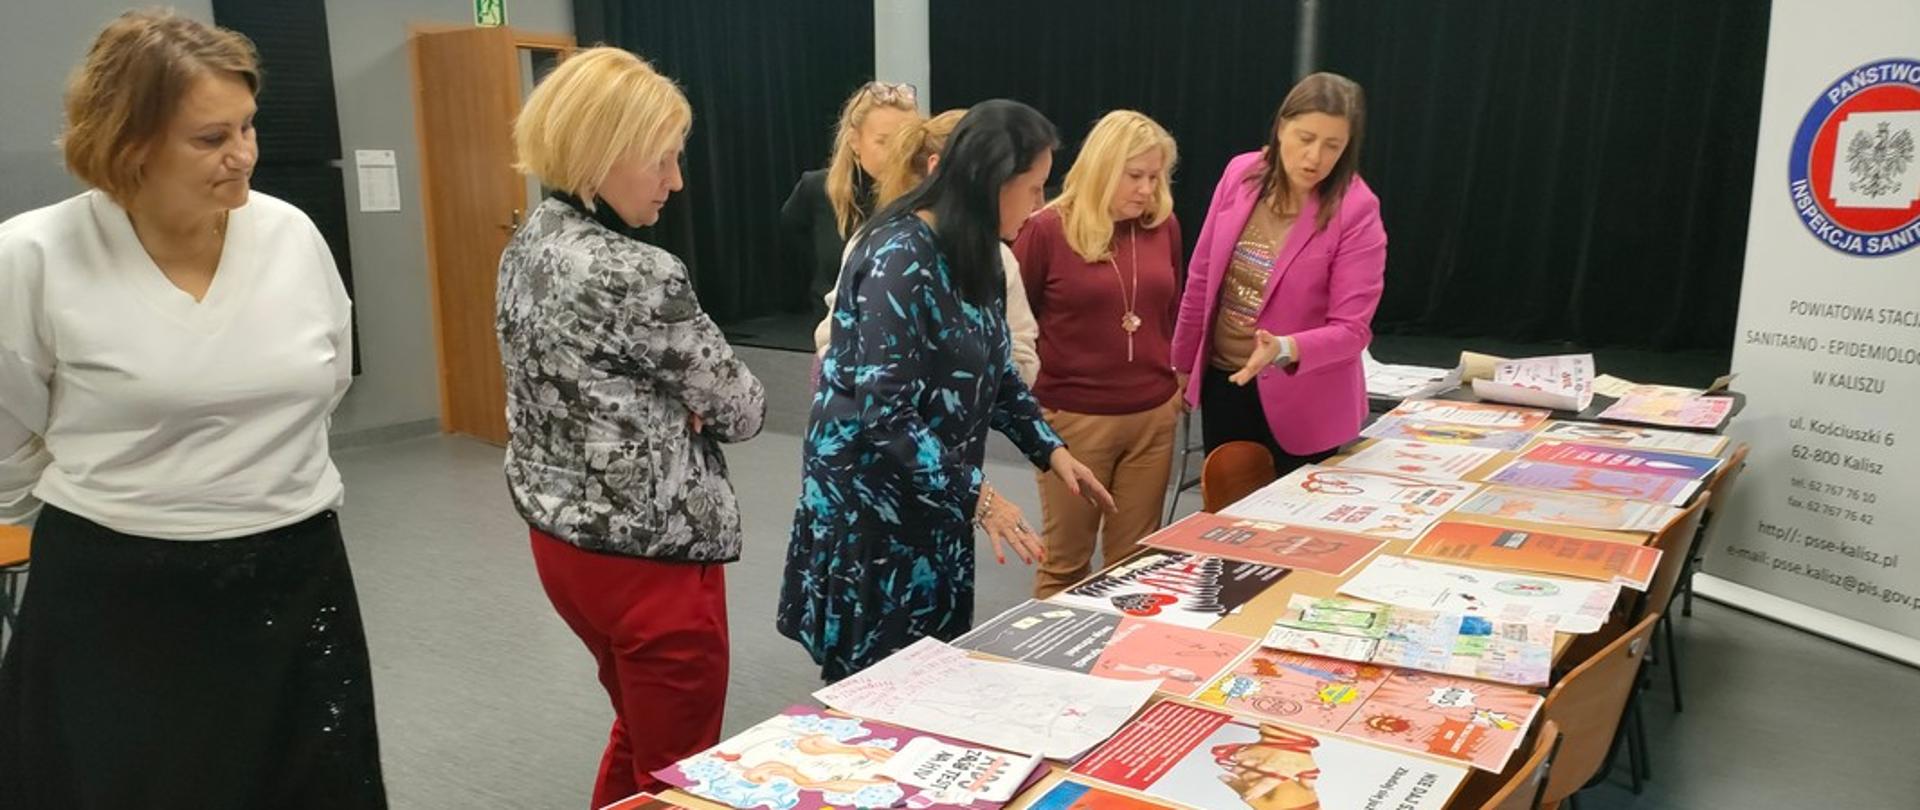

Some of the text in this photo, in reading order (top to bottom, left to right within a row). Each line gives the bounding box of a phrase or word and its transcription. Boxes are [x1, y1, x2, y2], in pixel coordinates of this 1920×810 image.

[1791, 179, 1863, 252] INSPEKCJA
[1790, 300, 1920, 327] POWIATOWA STACJ
[1746, 330, 1818, 351] SANITARNO
[1812, 371, 1886, 394] W KALISZU
[1790, 417, 1895, 446] ul. Kościuszki 6
[1791, 445, 1883, 475] 62-800 Kalisz
[1809, 480, 1822, 492] 62
[1846, 488, 1860, 500] 76
[1807, 500, 1821, 512] 62
[1844, 509, 1858, 521] 76
[1860, 514, 1874, 525] 42
[1726, 545, 1770, 566] e-mail:
[1758, 520, 1898, 568] http//: psse-kalisz.pl
[930, 769, 962, 791] TEST
[1416, 772, 1439, 788] NIE
[1403, 786, 1428, 804] DAJ
